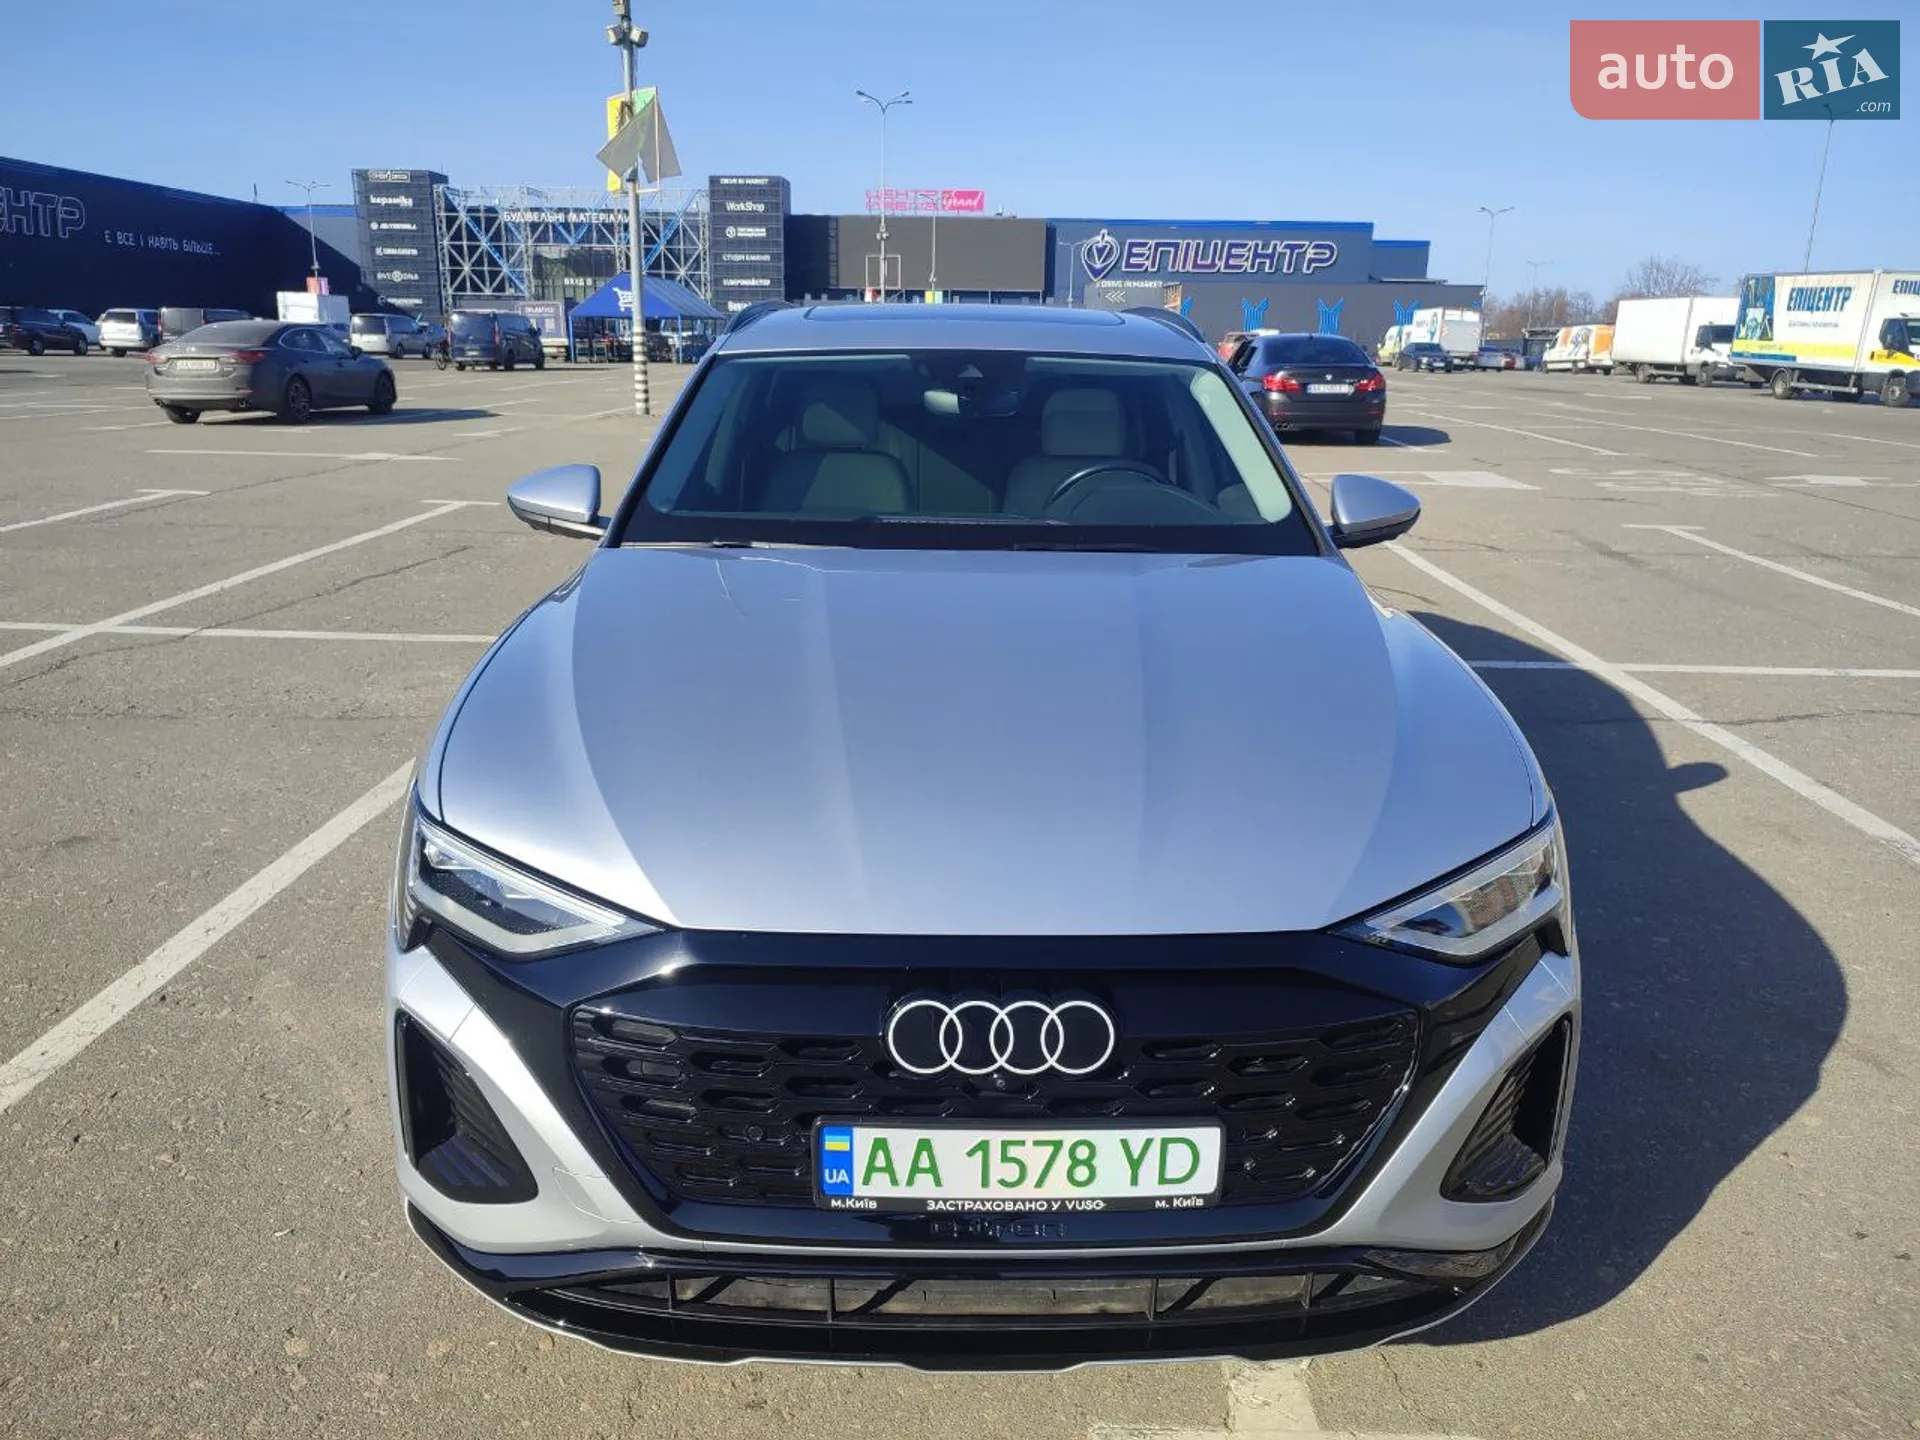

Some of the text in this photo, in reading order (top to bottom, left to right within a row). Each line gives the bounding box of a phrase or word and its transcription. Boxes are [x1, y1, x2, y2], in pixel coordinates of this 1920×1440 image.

[0, 186, 85, 238] НТР
[503, 211, 565, 223] БУДІВЕЛЬНІ
[726, 201, 765, 213] WorkShop
[116, 231, 135, 246] ВСЕ
[148, 235, 179, 251] НАВІТЬ
[1122, 240, 1338, 275] ЕПІЦЕНТР
[1787, 287, 1852, 313] ЕПІЦЕНТР
[861, 1137, 1200, 1189] AA 1578 YD
[825, 1168, 851, 1184] UA
[926, 1199, 1048, 1211] ЗАСТРАХОВАНО
[1051, 1200, 1061, 1211] У
